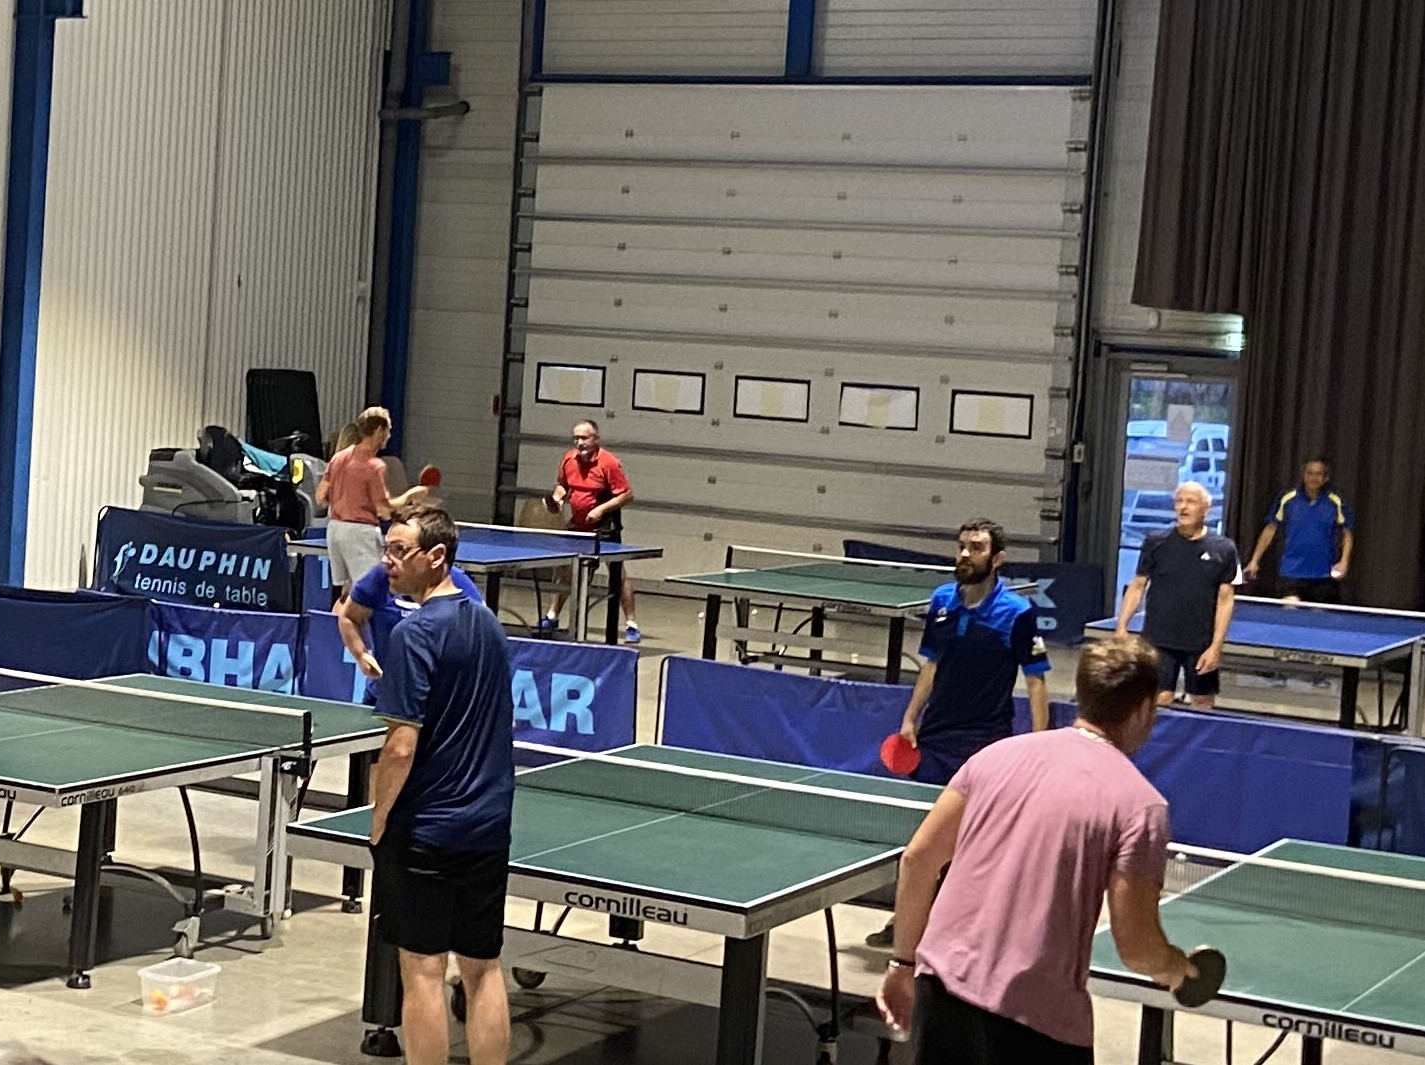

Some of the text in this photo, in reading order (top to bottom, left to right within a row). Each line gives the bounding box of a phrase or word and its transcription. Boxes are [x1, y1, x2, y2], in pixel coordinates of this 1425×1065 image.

[138, 543, 272, 581] DAUPHIN
[134, 573, 268, 607] tennis de table
[564, 891, 688, 926] cornilleau
[1262, 1013, 1395, 1049] cornilleau
